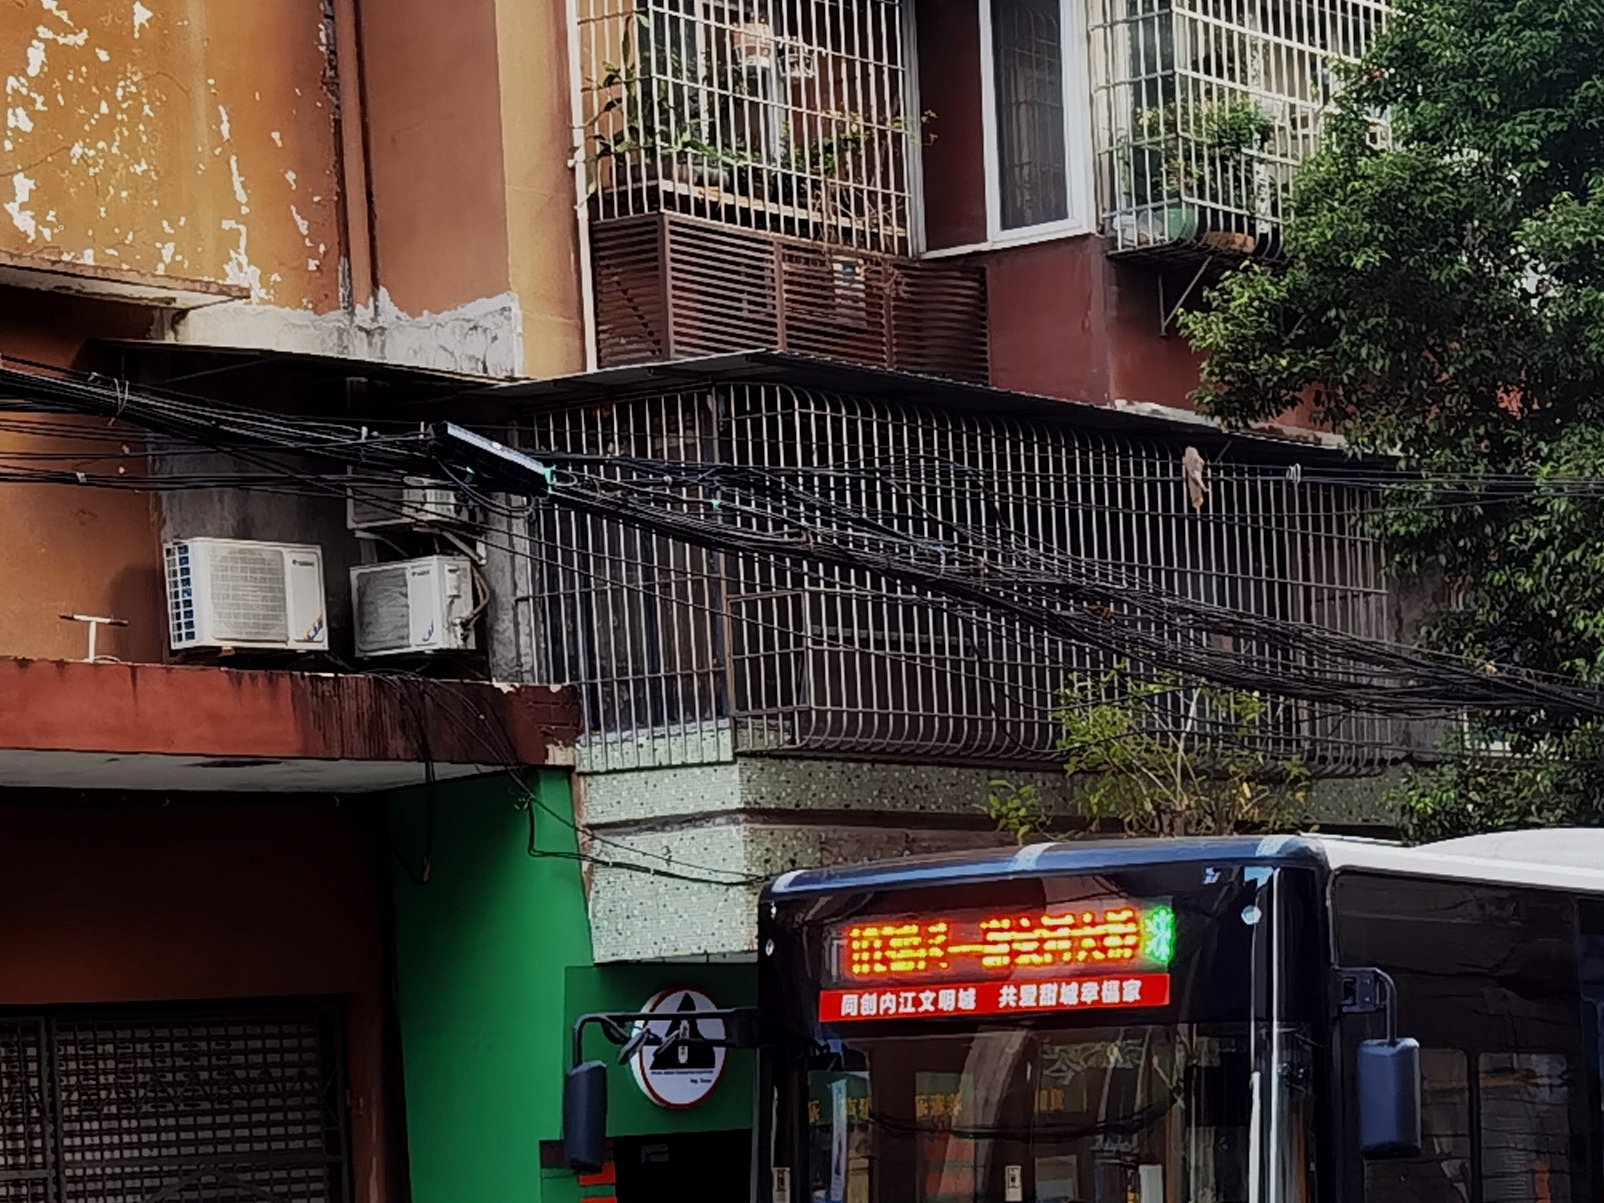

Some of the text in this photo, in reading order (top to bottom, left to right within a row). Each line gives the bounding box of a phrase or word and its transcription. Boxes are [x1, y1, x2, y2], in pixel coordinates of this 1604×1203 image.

[841, 987, 977, 1016] 同创内江文明城
